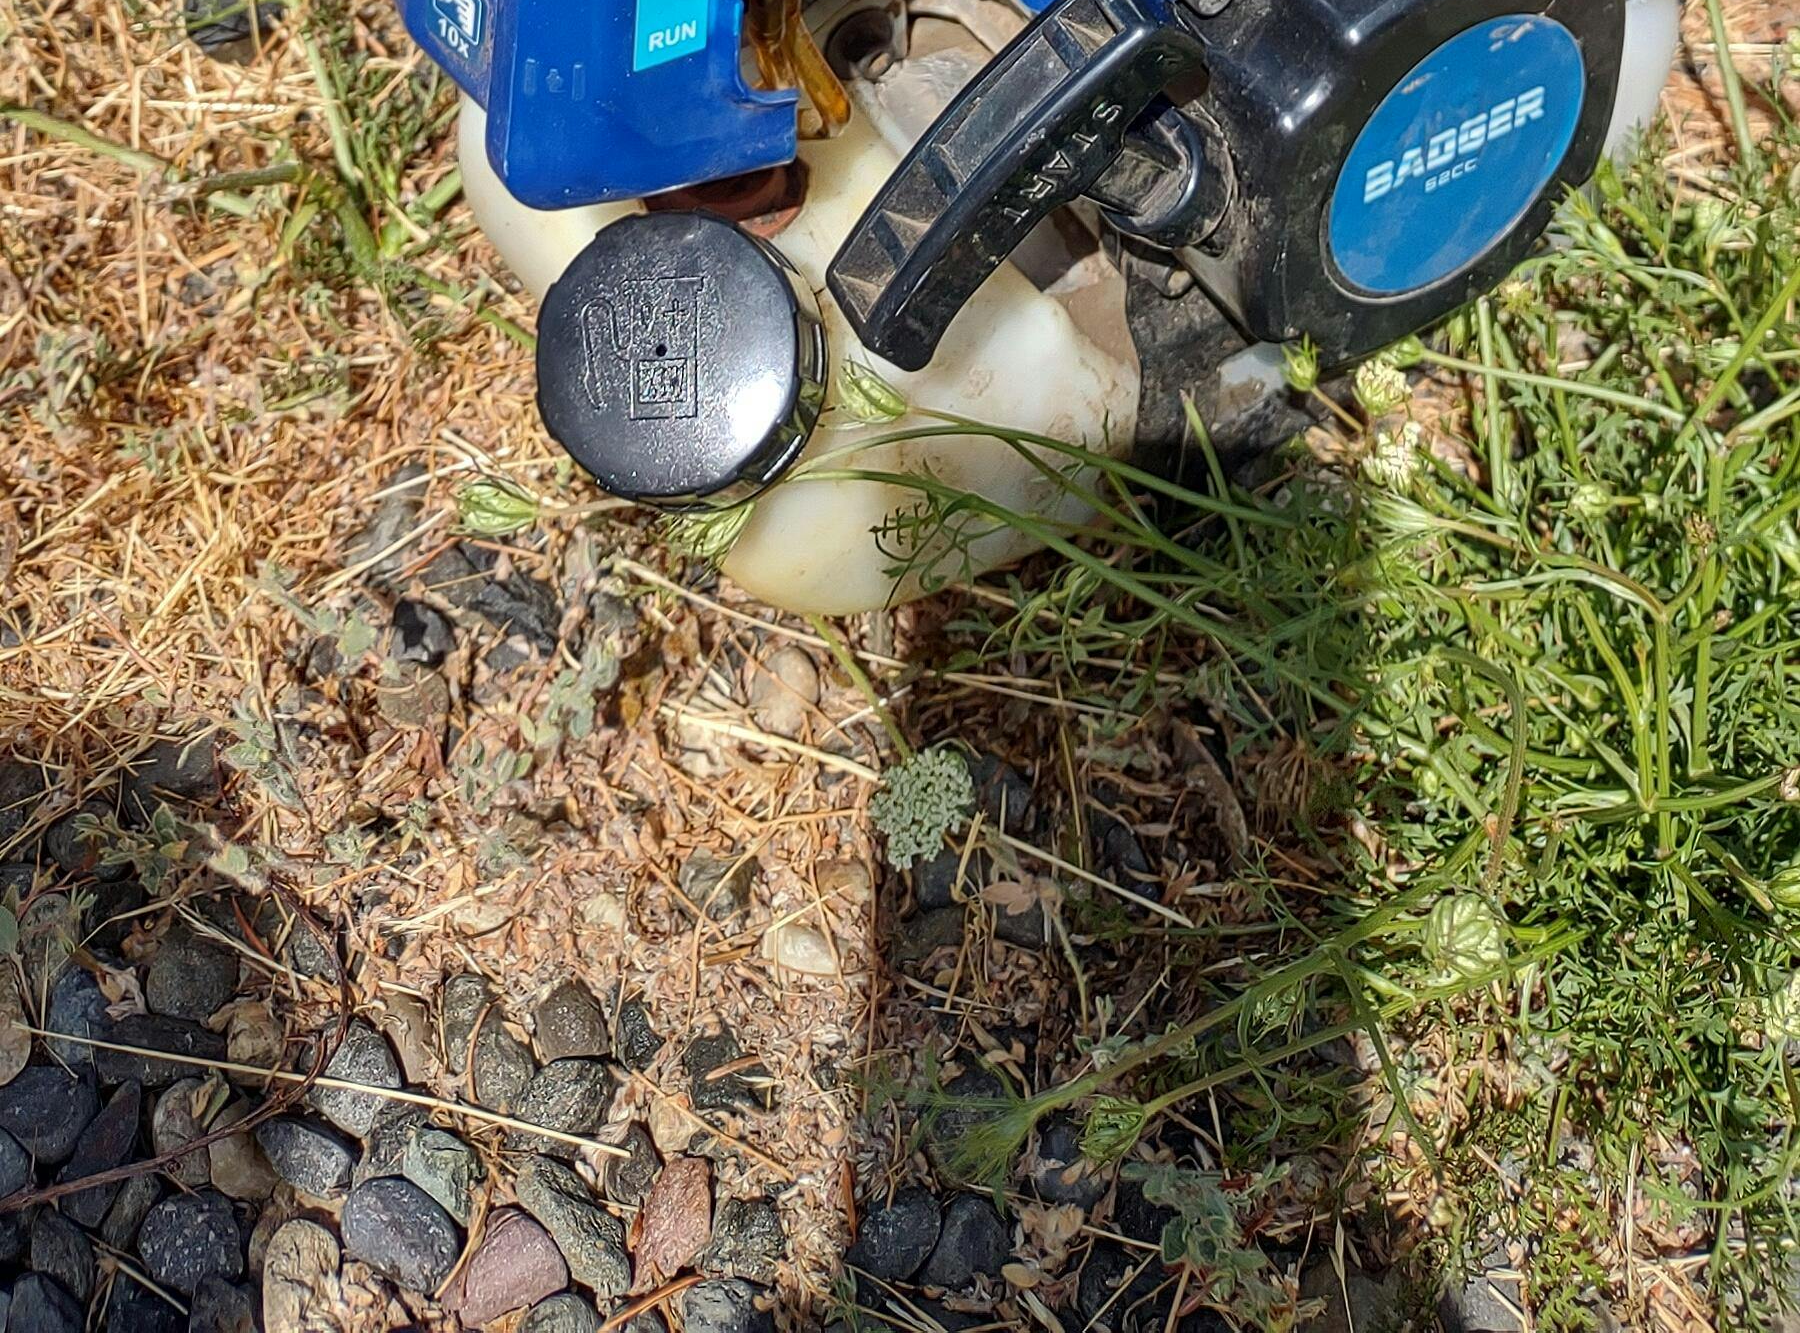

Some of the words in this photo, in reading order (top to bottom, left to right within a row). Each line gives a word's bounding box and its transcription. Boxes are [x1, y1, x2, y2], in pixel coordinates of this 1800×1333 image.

[648, 19, 697, 53] RUN
[1003, 101, 1123, 226] START
[1363, 85, 1546, 205] BADGER
